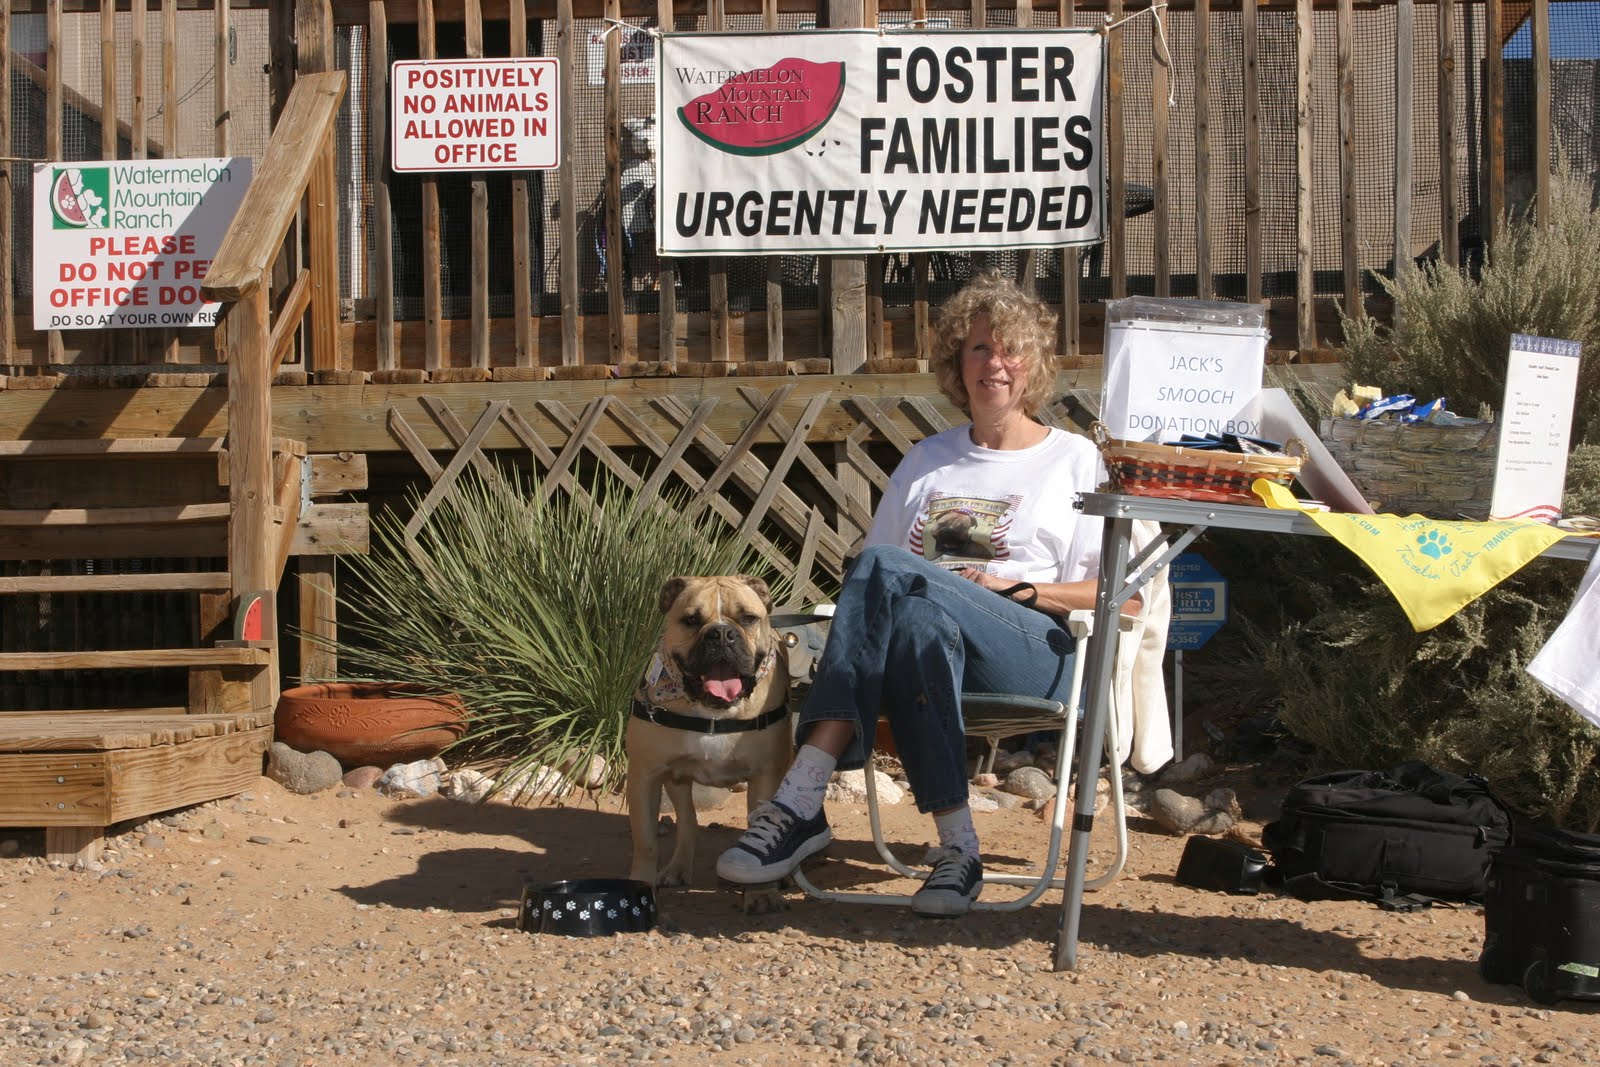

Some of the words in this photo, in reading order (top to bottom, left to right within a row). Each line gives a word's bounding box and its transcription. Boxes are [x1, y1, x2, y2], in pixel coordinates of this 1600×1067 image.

[407, 67, 544, 89] POSITIVELY
[675, 67, 804, 85] WATERMELON
[876, 46, 1076, 103] FOSTER
[403, 94, 436, 114] NO
[443, 92, 549, 113] ANIMALS
[717, 87, 812, 104] MOUNTAIN
[695, 102, 784, 125] RANCH
[404, 117, 516, 139] ALLOWED
[523, 117, 547, 137] IN
[434, 143, 517, 164] OFFICE
[860, 115, 1093, 174] FAMILIES
[114, 163, 231, 185] Watermelon
[114, 188, 203, 208] Mountain
[114, 208, 173, 229] Ranch
[675, 189, 907, 238] URGENTLY
[917, 184, 1093, 235] NEEDED
[90, 235, 195, 256] PLEASE
[59, 263, 97, 282] DO
[107, 262, 164, 281] NOT
[174, 260, 213, 280] PE
[50, 286, 148, 308] OFFICE
[159, 286, 215, 305] DO
[51, 314, 71, 327] DO
[75, 314, 94, 326] SO
[98, 314, 115, 325] AT
[119, 313, 157, 325] YOUR
[164, 312, 194, 325] OWN
[198, 312, 218, 324] RIS
[1169, 355, 1224, 373] JACK'S
[1157, 386, 1235, 405] SMOOCH
[1129, 414, 1220, 434] DONATION
[1226, 420, 1259, 436] BOX
[1169, 564, 1201, 572] TECTED
[1451, 551, 1483, 579] Jack
[1173, 599, 1213, 608] URITY
[1175, 591, 1201, 599] RST
[1168, 635, 1199, 643] 6-3545
